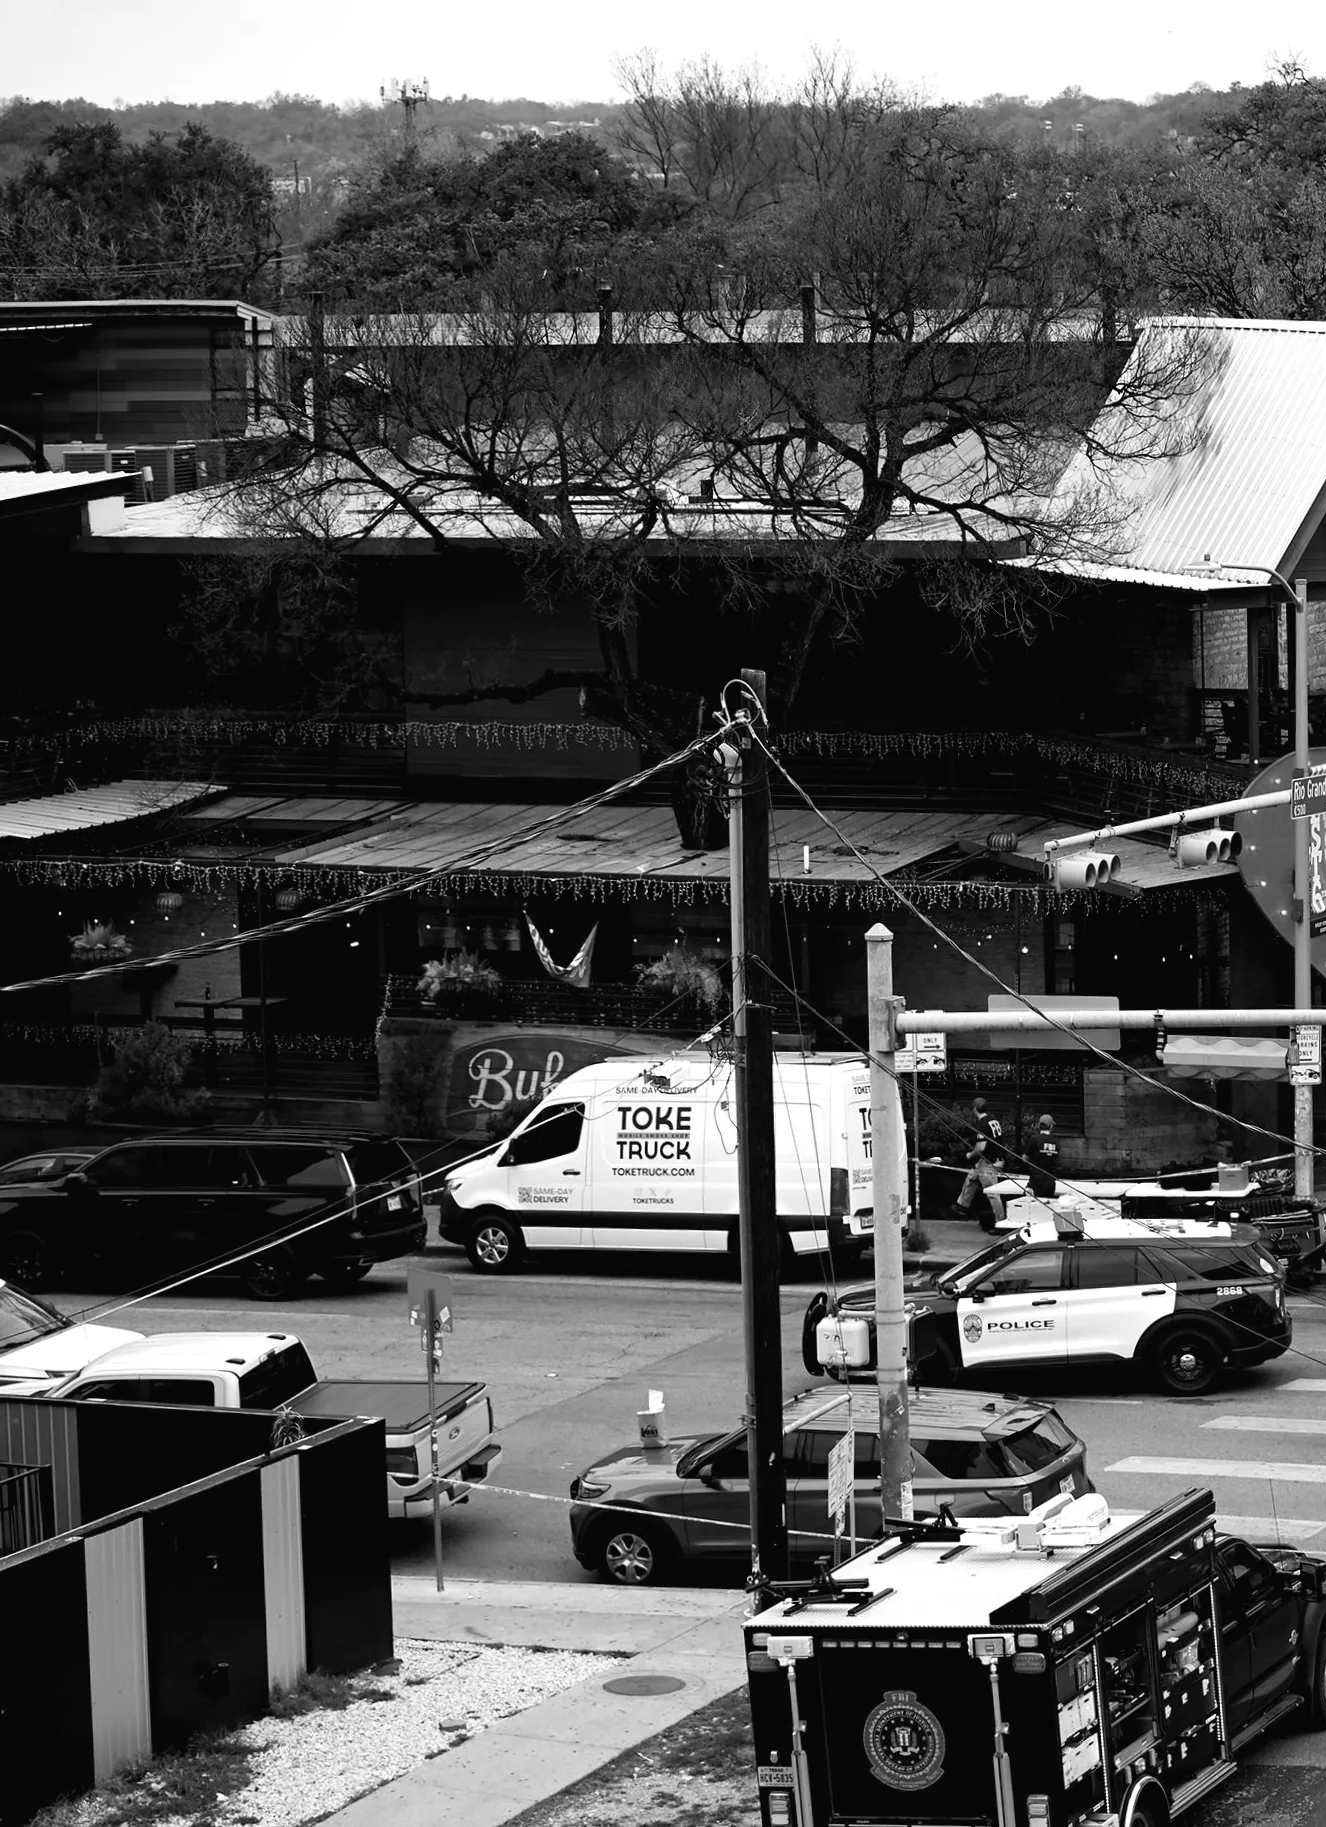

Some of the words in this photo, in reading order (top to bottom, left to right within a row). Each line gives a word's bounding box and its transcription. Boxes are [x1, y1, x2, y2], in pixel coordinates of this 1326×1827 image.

[1294, 781, 1305, 800] Rio
[617, 1106, 692, 1131] TOKE
[617, 1141, 691, 1160] TRUCK
[1044, 1143, 1056, 1151] FBI
[612, 1168, 695, 1177] TOKETRUCK.COM
[533, 1187, 573, 1196] SAME-DAY
[533, 1196, 569, 1204] DELIVERY
[1216, 1286, 1243, 1296] 2868
[987, 1320, 1055, 1330] POLICE
[891, 1693, 909, 1702] FBI
